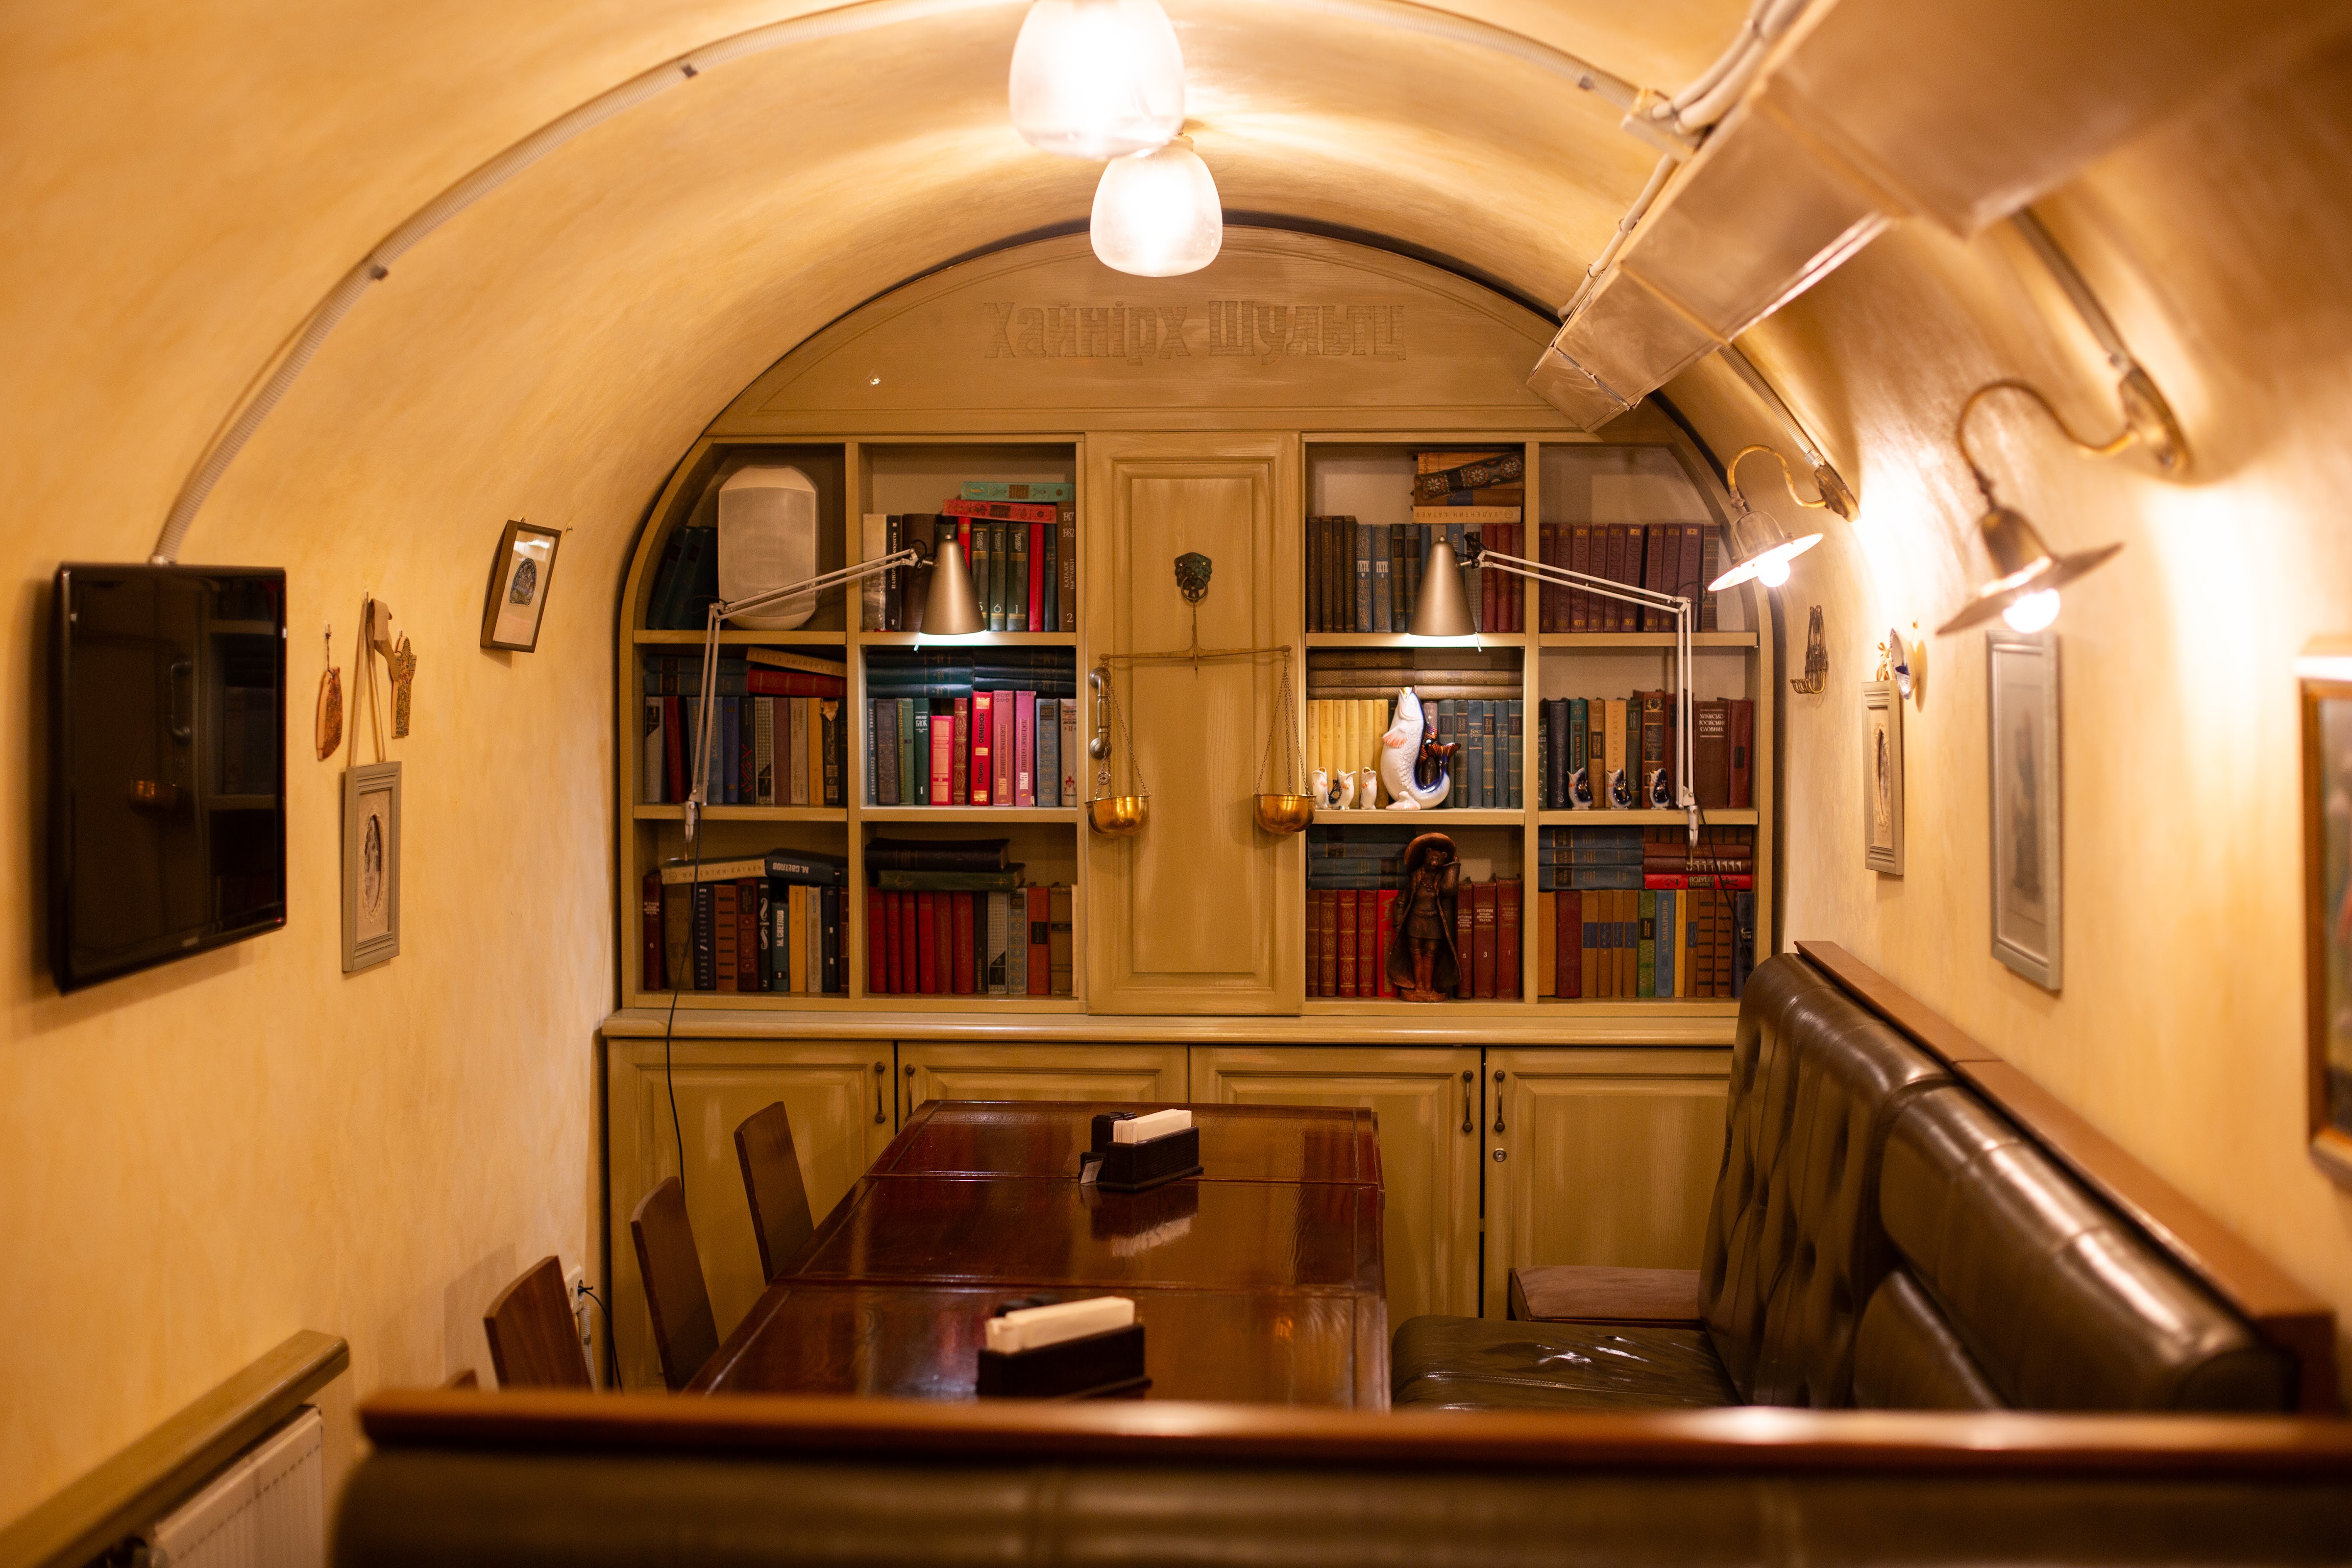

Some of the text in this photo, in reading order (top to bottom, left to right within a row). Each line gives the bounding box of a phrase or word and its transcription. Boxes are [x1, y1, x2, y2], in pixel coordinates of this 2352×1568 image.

[983, 301, 1406, 366] Хайнірх Шультц
[1063, 512, 1074, 521] 1917
[1063, 528, 1075, 537] 1982
[994, 603, 1002, 613] 6
[1015, 605, 1018, 614] 1
[1067, 613, 1074, 622] 2
[731, 865, 761, 875] КАТАЕВ
[772, 862, 809, 874] М. СВЕТЛОВ
